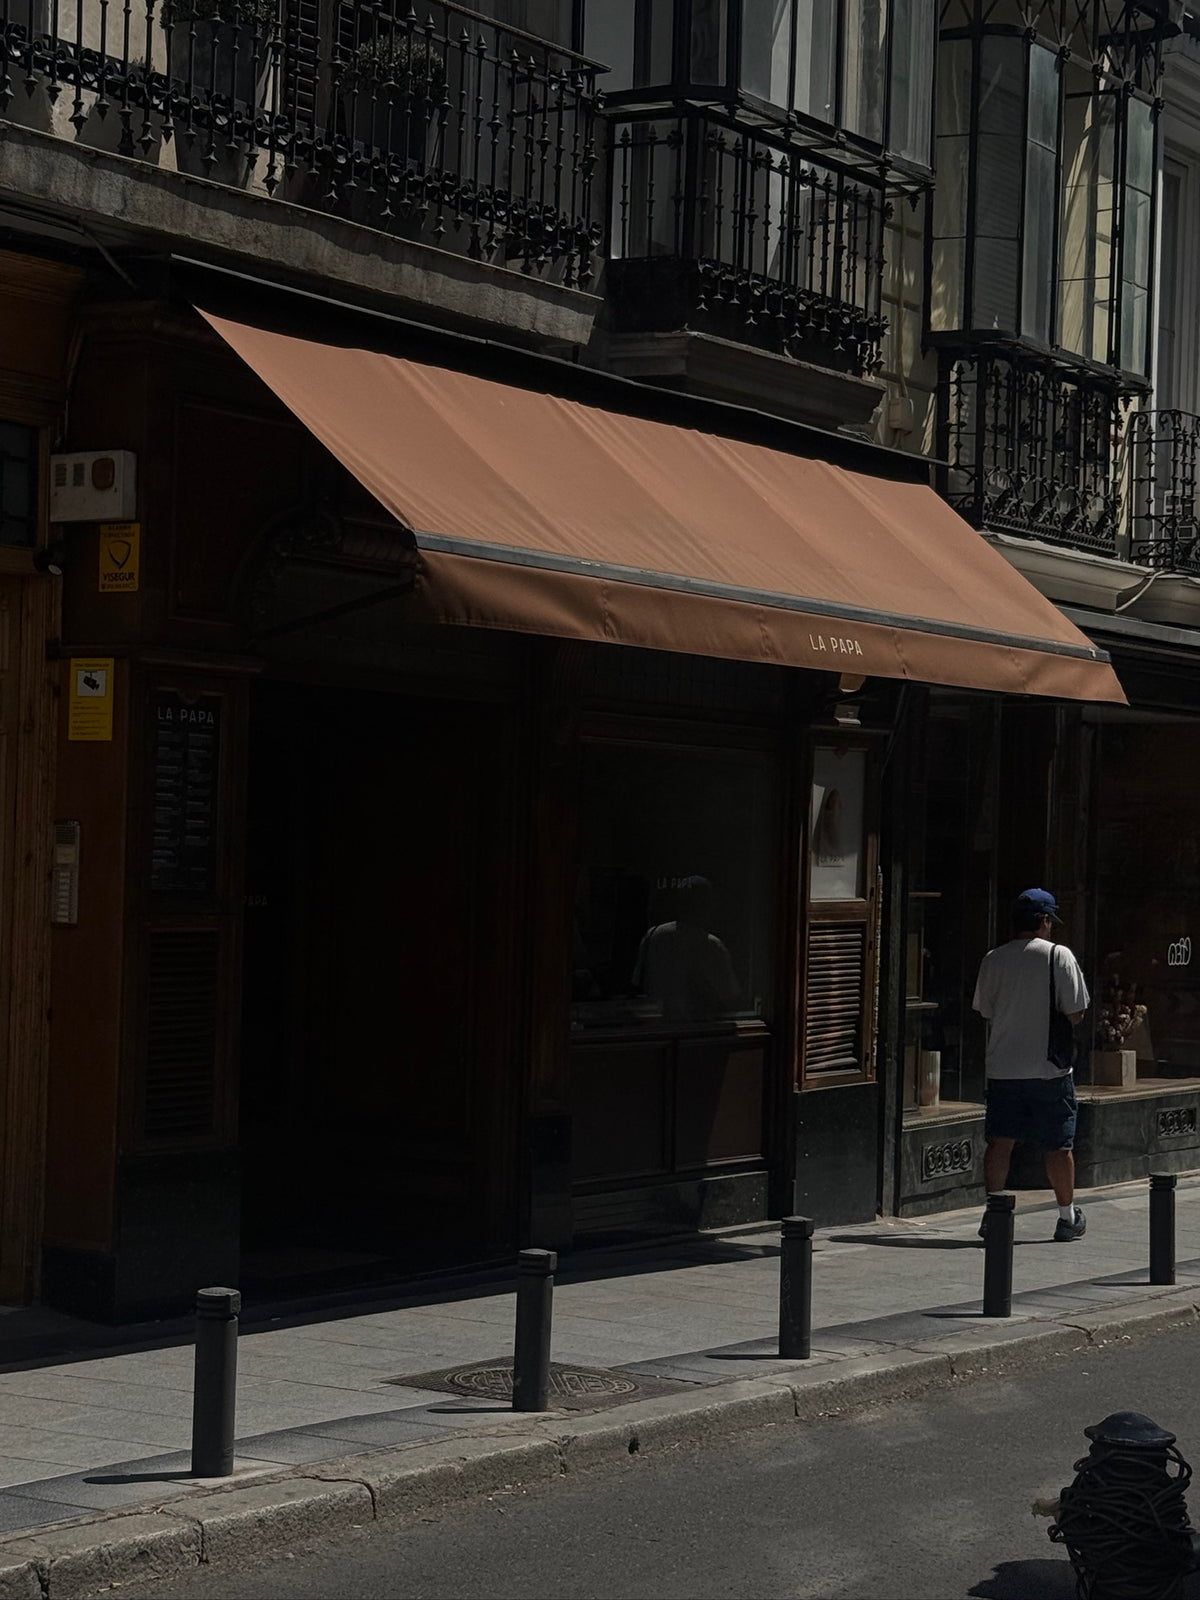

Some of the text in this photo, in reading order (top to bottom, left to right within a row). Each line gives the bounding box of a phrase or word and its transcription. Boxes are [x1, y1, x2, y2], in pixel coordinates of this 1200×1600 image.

[808, 633, 864, 656] LA PAPA
[157, 706, 215, 725] LA PAPA
[656, 877, 667, 889] LA
